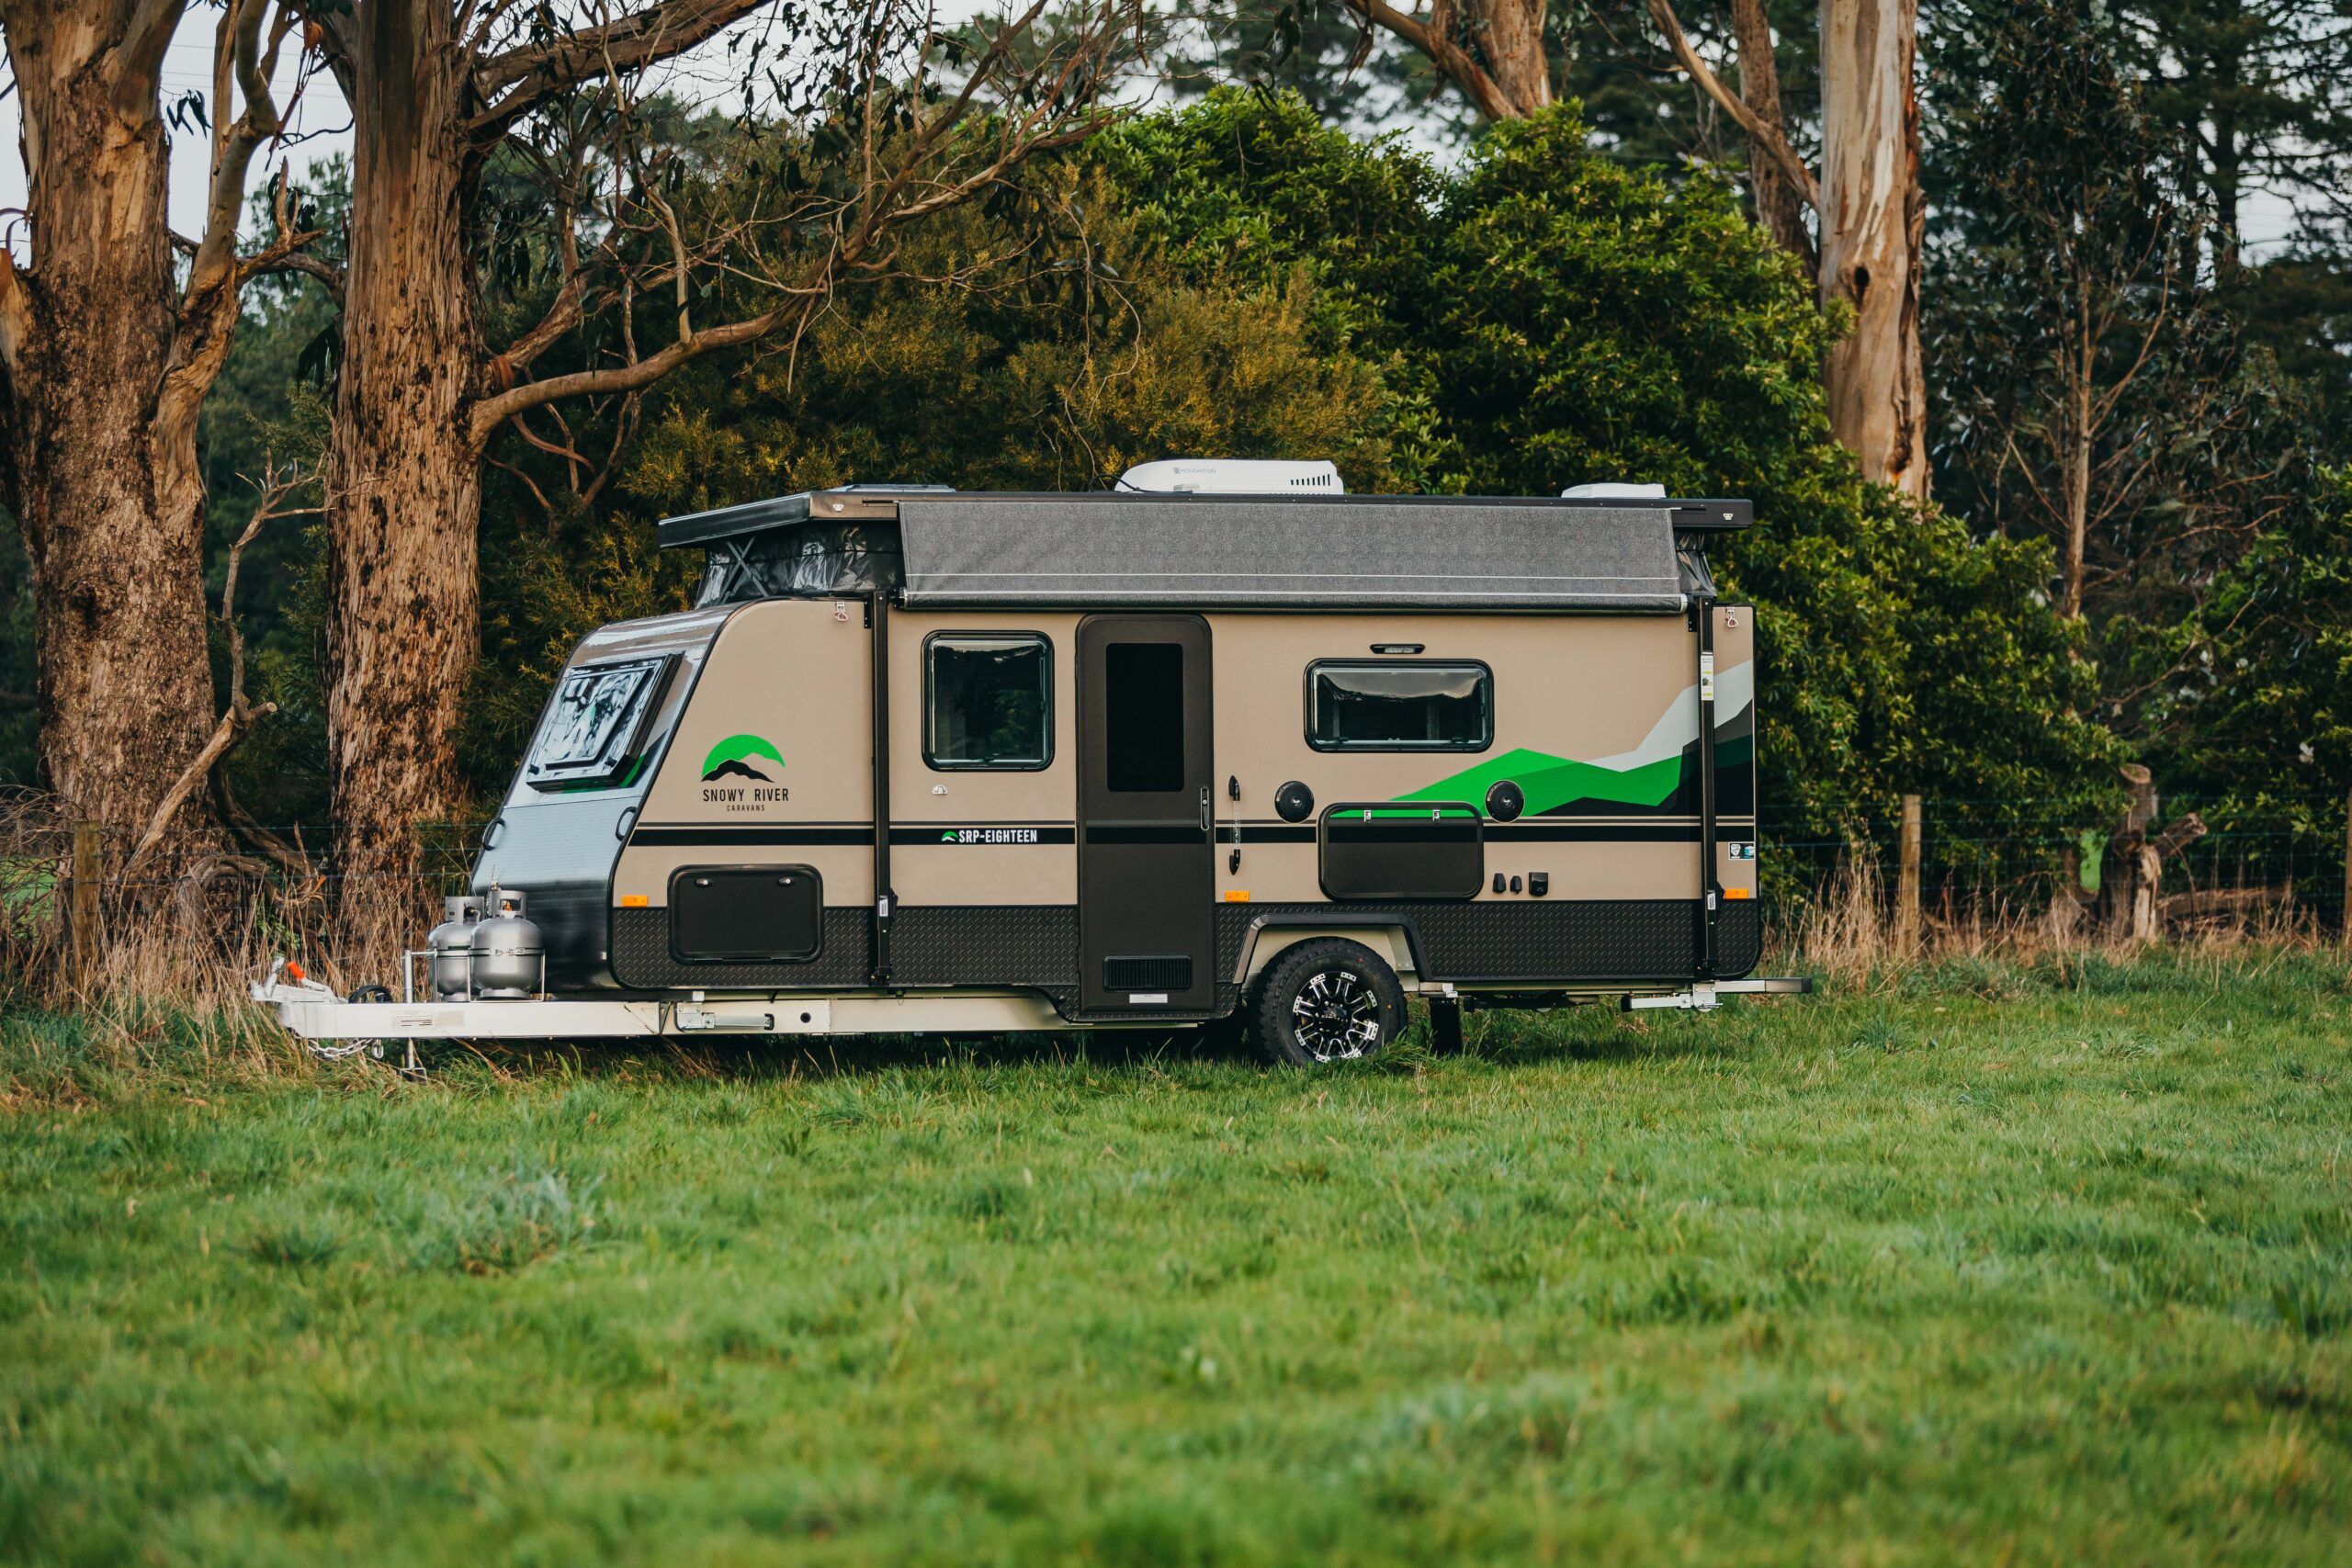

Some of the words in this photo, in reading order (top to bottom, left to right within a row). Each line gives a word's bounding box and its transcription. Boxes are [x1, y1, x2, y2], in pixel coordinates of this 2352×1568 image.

[703, 789, 745, 802] SNOWY
[754, 788, 789, 802] RIVER
[958, 829, 1037, 843] SRP-EIGHTEEN
